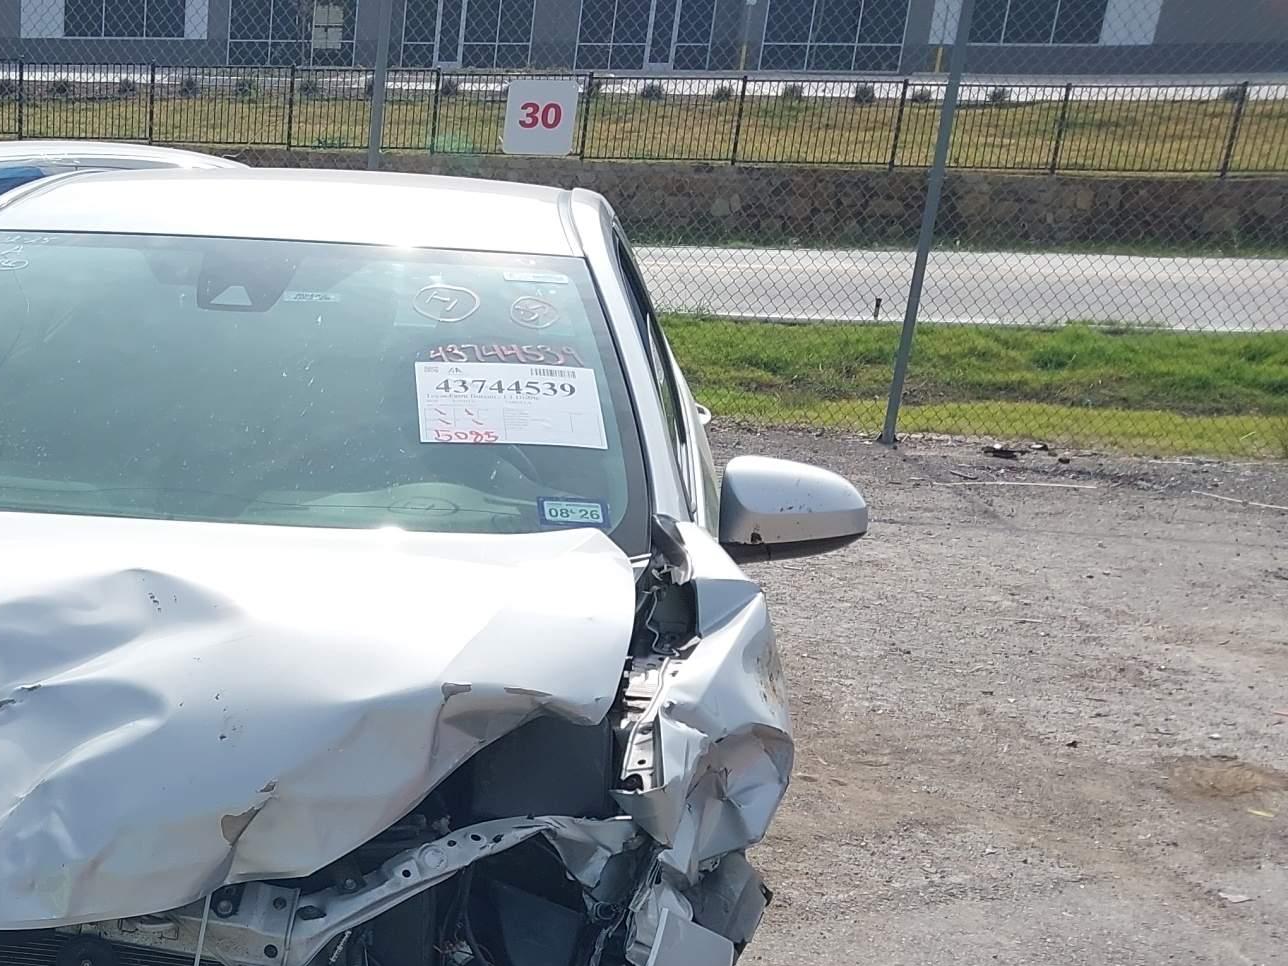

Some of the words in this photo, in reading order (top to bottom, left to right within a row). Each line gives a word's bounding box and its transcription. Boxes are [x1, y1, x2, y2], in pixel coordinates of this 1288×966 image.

[518, 102, 562, 129] 30
[429, 344, 585, 368] 43744539
[435, 379, 576, 397] 43744539
